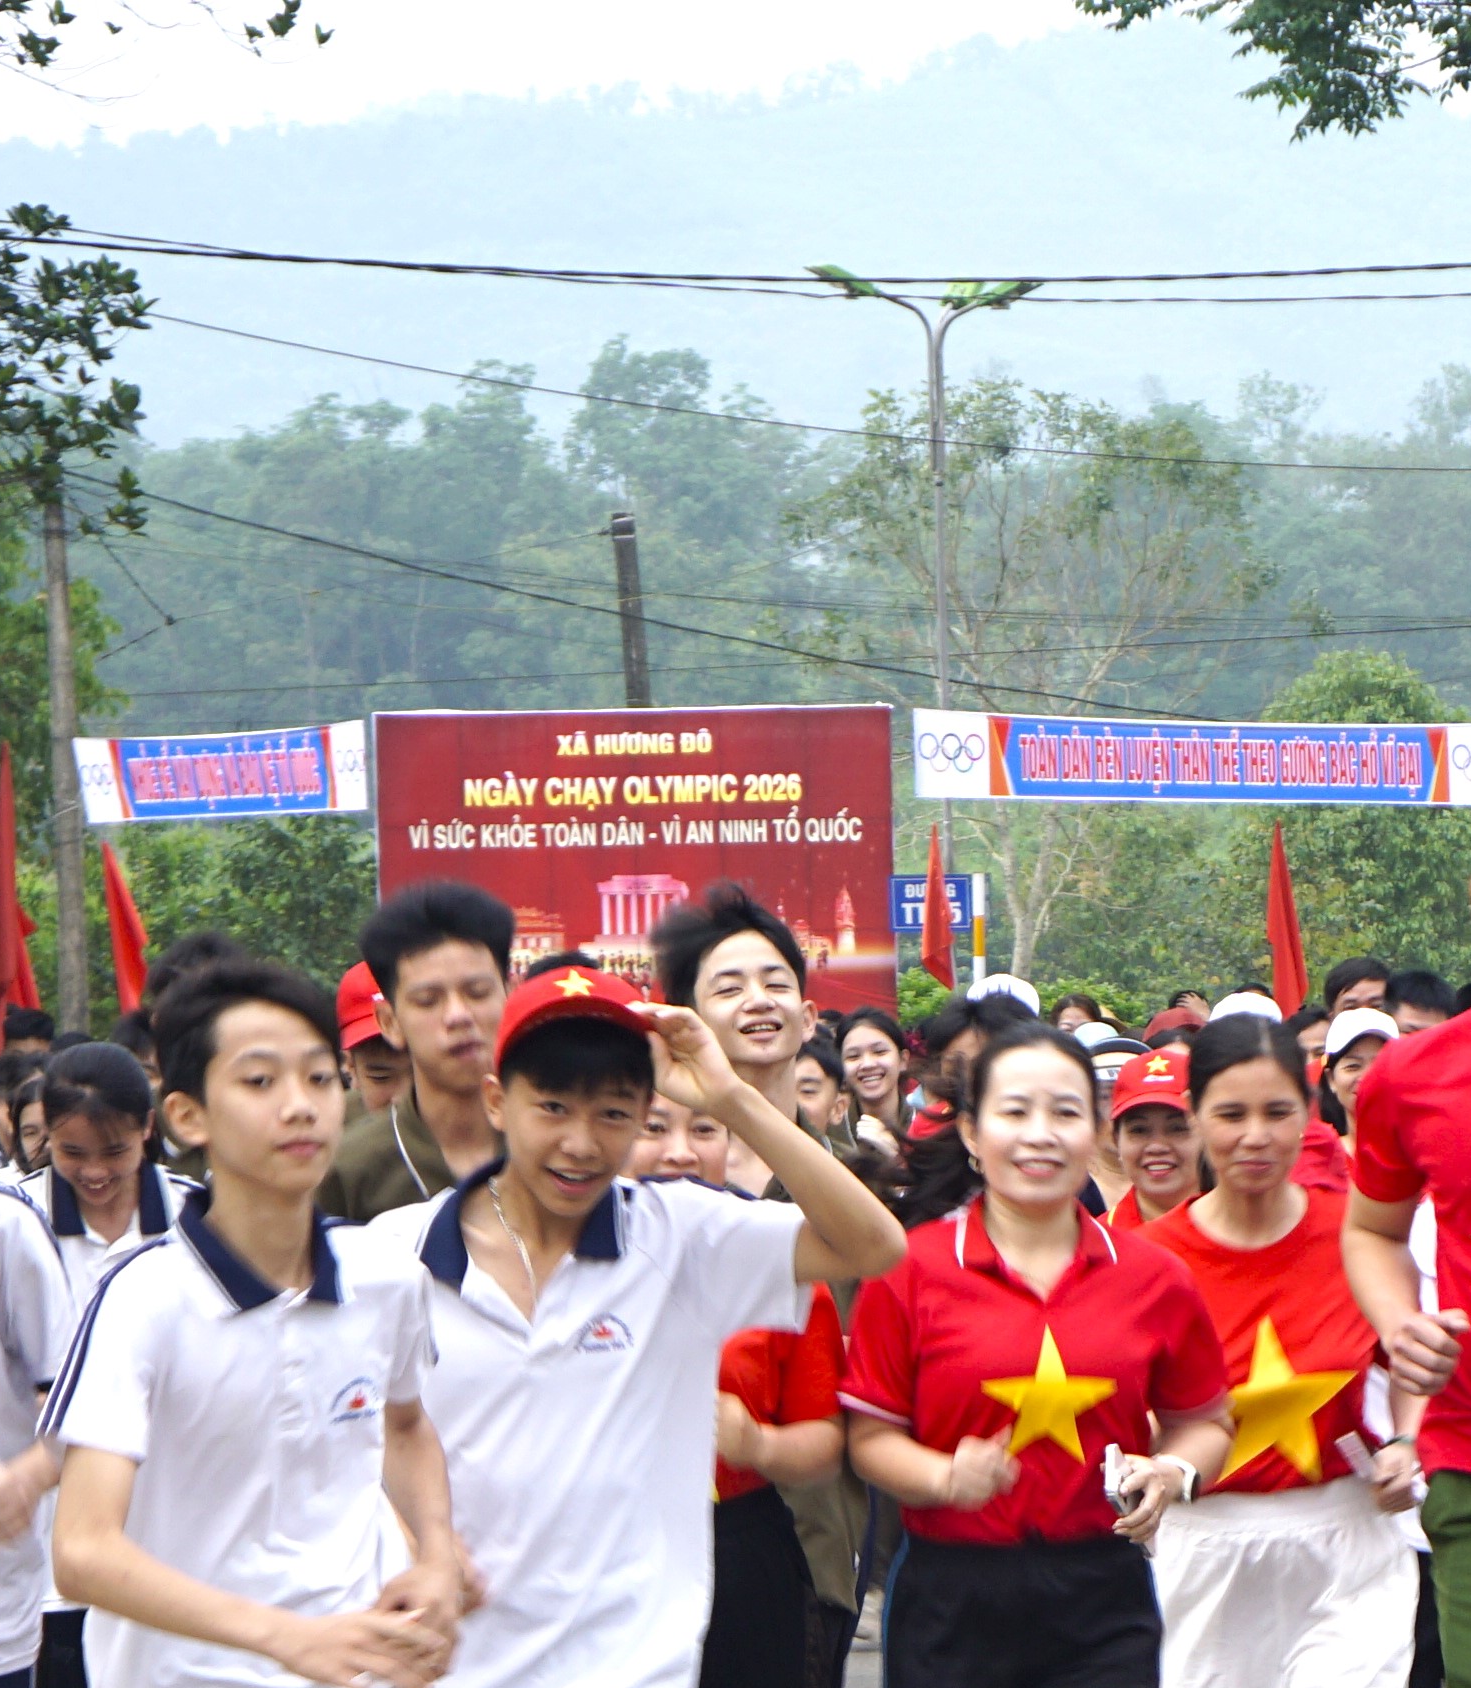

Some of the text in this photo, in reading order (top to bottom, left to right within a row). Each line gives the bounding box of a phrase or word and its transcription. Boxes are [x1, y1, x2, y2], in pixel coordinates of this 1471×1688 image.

[556, 727, 713, 756] XÃ HƯƠNG ĐÔ
[1019, 725, 1059, 781] TOÀN
[1061, 726, 1092, 782] DÂN
[1094, 726, 1124, 783] RÈN
[1126, 727, 1172, 794] LUYỆN
[1173, 729, 1212, 784] THÂN
[1213, 728, 1241, 785] THỂ
[1241, 739, 1276, 786] THEO
[1280, 735, 1327, 786] GƯƠNG
[1329, 732, 1357, 787] BÁC
[1359, 728, 1379, 787] HỒ
[1397, 742, 1422, 797] ĐẠI
[463, 770, 803, 811] NGÀY CHẠY OLYMPIC 2026
[408, 818, 429, 849] VÌ
[433, 817, 476, 849] SỨC
[480, 814, 537, 848] KHỎE
[541, 816, 596, 847] TOÀN
[601, 815, 644, 846] DÂN
[661, 813, 681, 844] VÌ
[685, 819, 714, 844] AN
[719, 818, 767, 843] NINH
[772, 805, 801, 843] TỔ
[804, 807, 863, 843] QUỐC
[903, 882, 956, 898] ĐƯG
